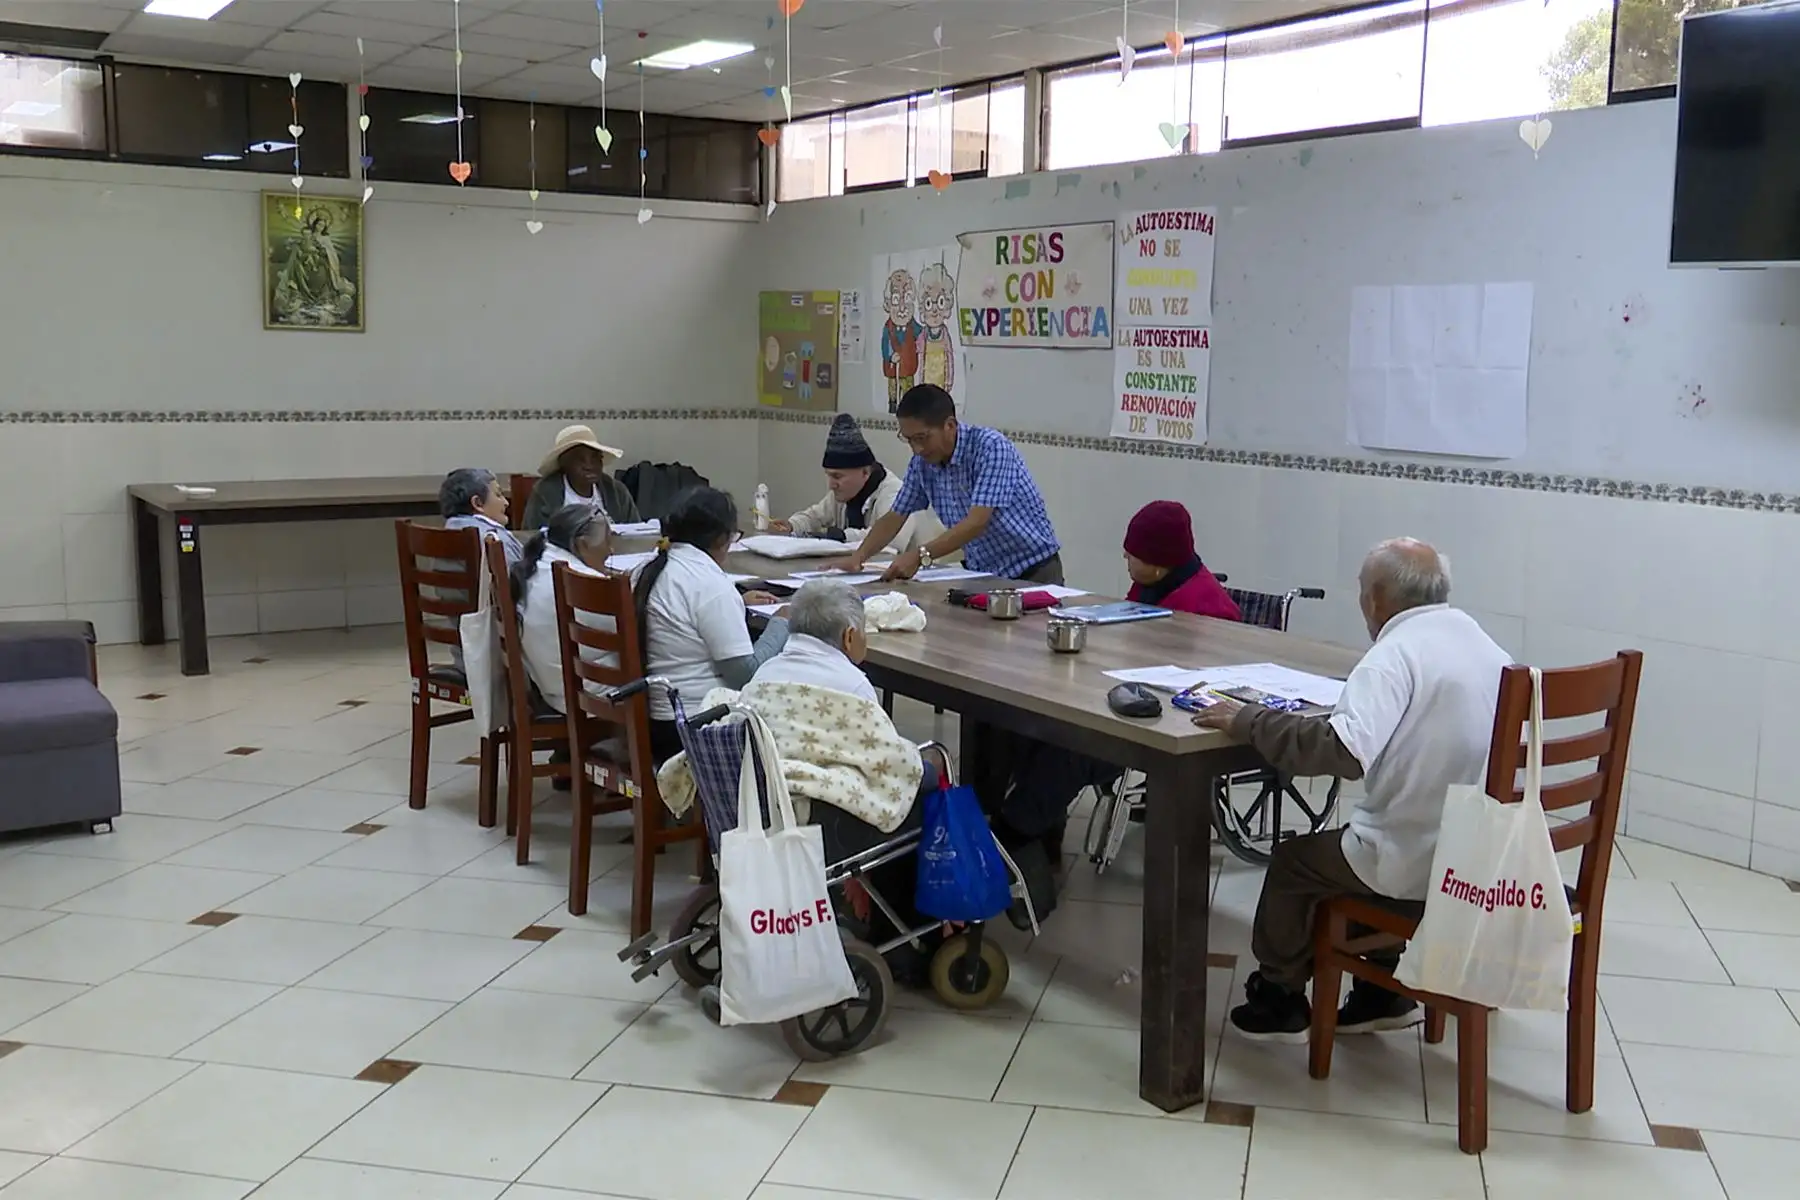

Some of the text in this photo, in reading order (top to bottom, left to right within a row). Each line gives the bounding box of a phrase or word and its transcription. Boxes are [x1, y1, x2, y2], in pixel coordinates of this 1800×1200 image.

[1120, 211, 1214, 246] LA AUTOESTIMA
[995, 232, 1064, 265] RISAS
[1139, 239, 1181, 258] NO SE
[1005, 269, 1055, 303] CON
[1128, 297, 1189, 316] UNA VEZ
[959, 306, 1110, 338] EXPERIENCIA
[1117, 329, 1209, 348] LA AUTOESTIMA
[1137, 349, 1186, 369] ES UNA
[1125, 371, 1197, 394] CONSTANTE
[1120, 393, 1197, 419] RENOVACIÓN
[1129, 415, 1194, 440] DE VOTOS
[1440, 867, 1547, 912] Ermengildo G.
[750, 899, 832, 936] Gladys F.
